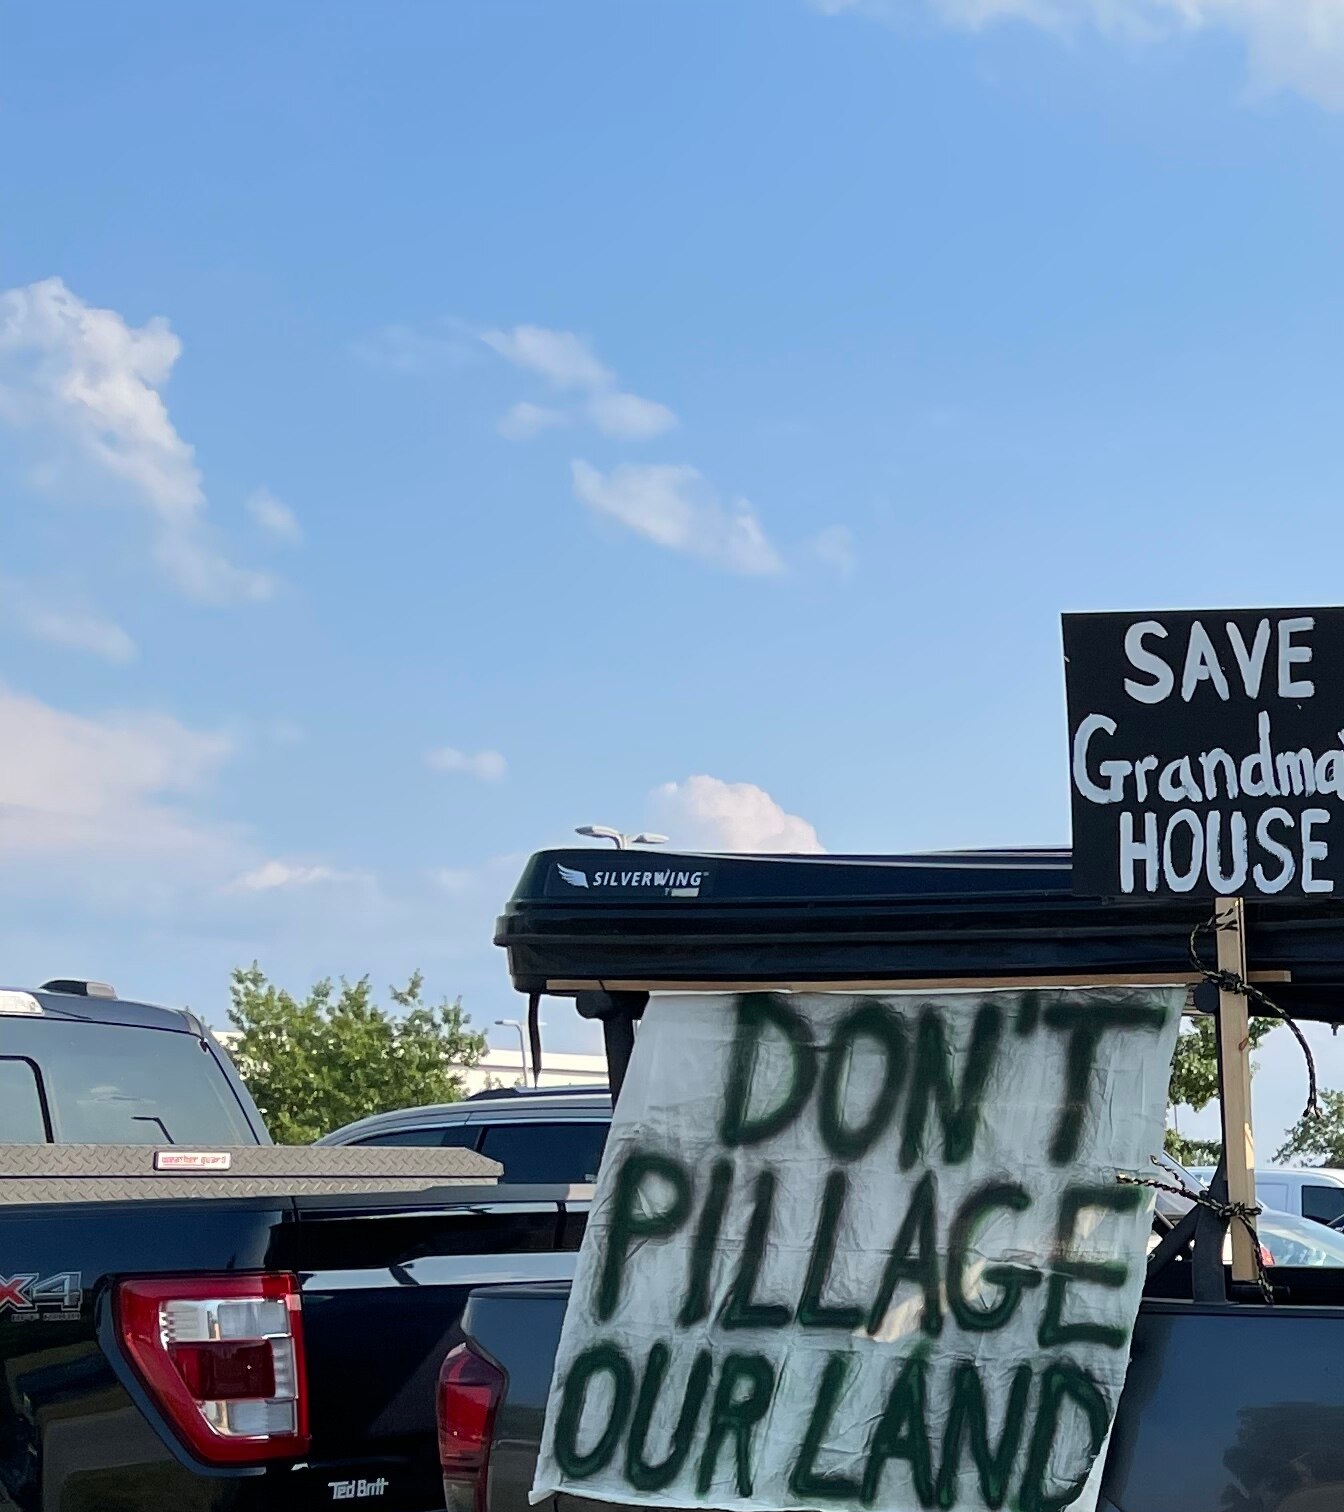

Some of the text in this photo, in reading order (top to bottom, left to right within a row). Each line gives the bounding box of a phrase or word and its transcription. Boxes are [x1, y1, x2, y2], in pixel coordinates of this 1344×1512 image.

[1123, 616, 1316, 704] SAVE
[592, 868, 702, 887] SILVERWING
[1118, 806, 1334, 893] HOUSE
[720, 992, 1168, 1170] DON'T
[598, 1151, 1143, 1348] PILLAGE
[554, 1339, 776, 1497] OUR
[328, 1480, 356, 1499] Ted
